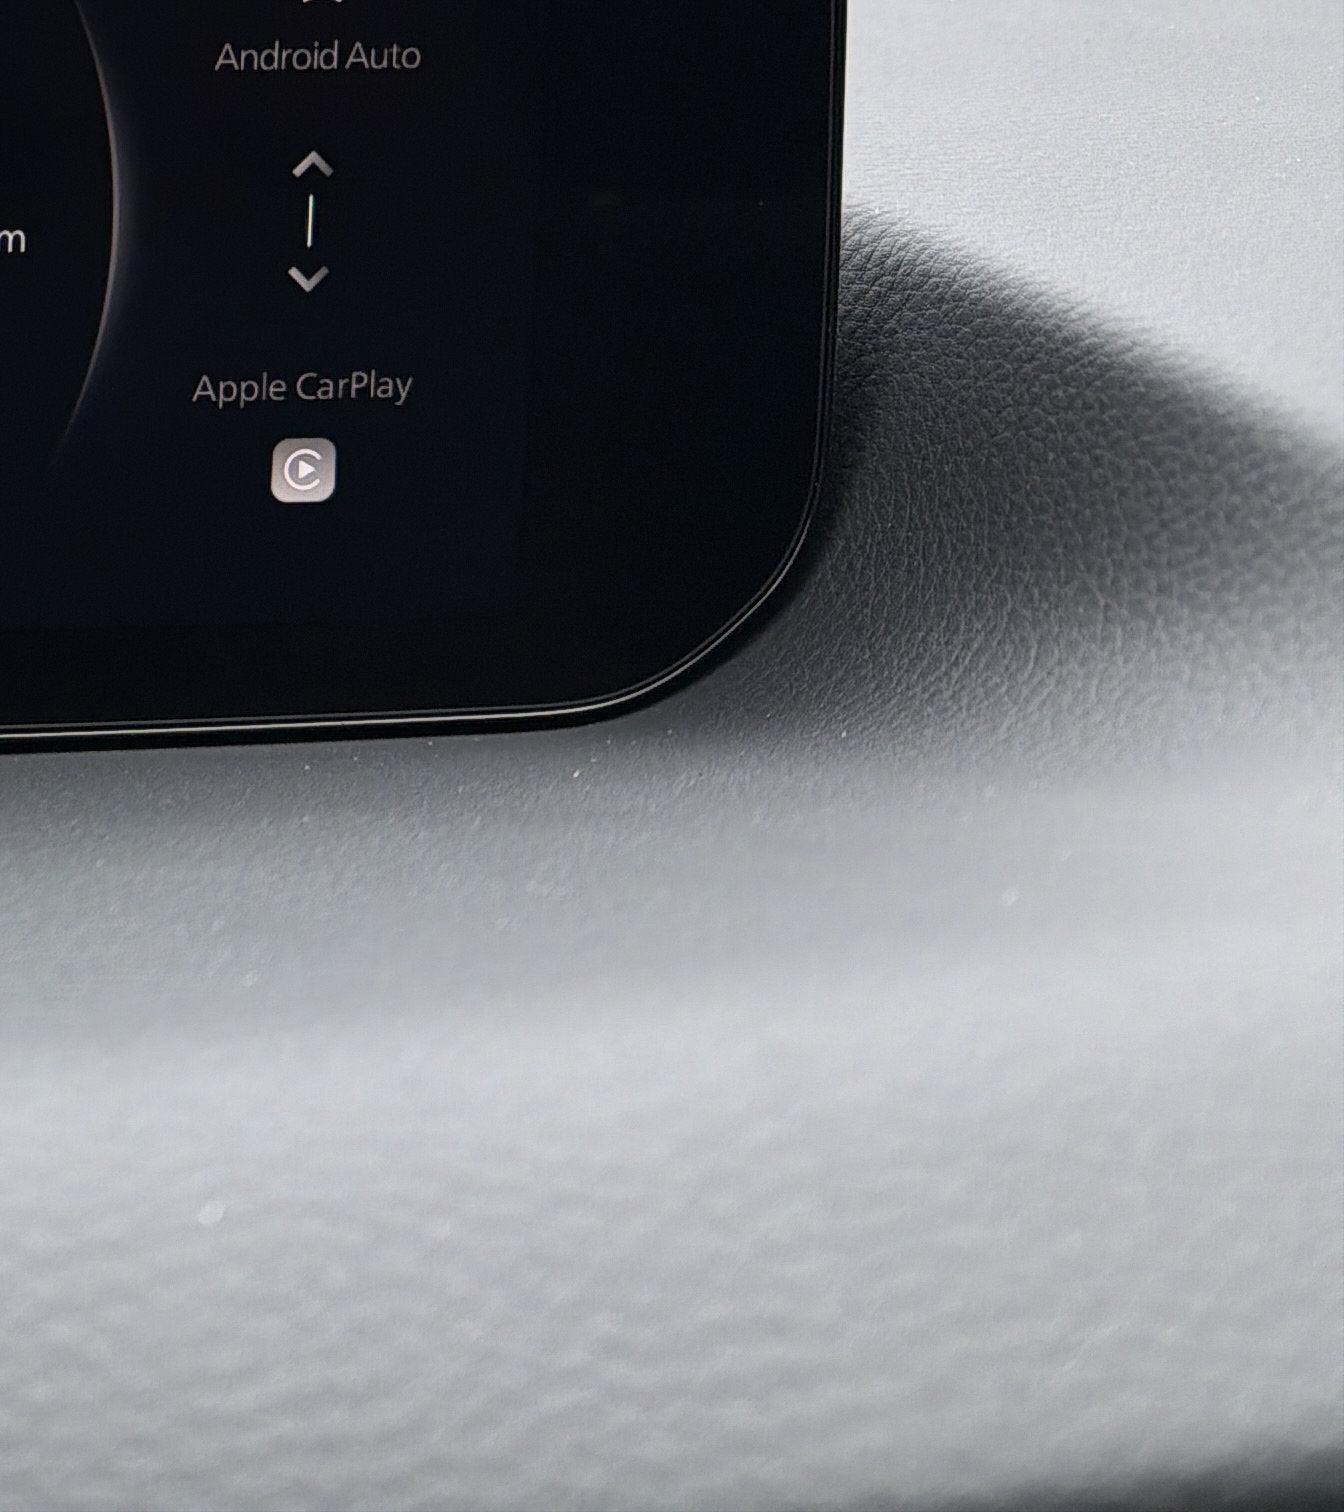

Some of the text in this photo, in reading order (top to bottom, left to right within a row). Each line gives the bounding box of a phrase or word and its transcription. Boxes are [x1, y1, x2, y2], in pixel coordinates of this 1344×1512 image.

[214, 39, 422, 72] Android Auto
[191, 368, 414, 410] Apple CarPlay
